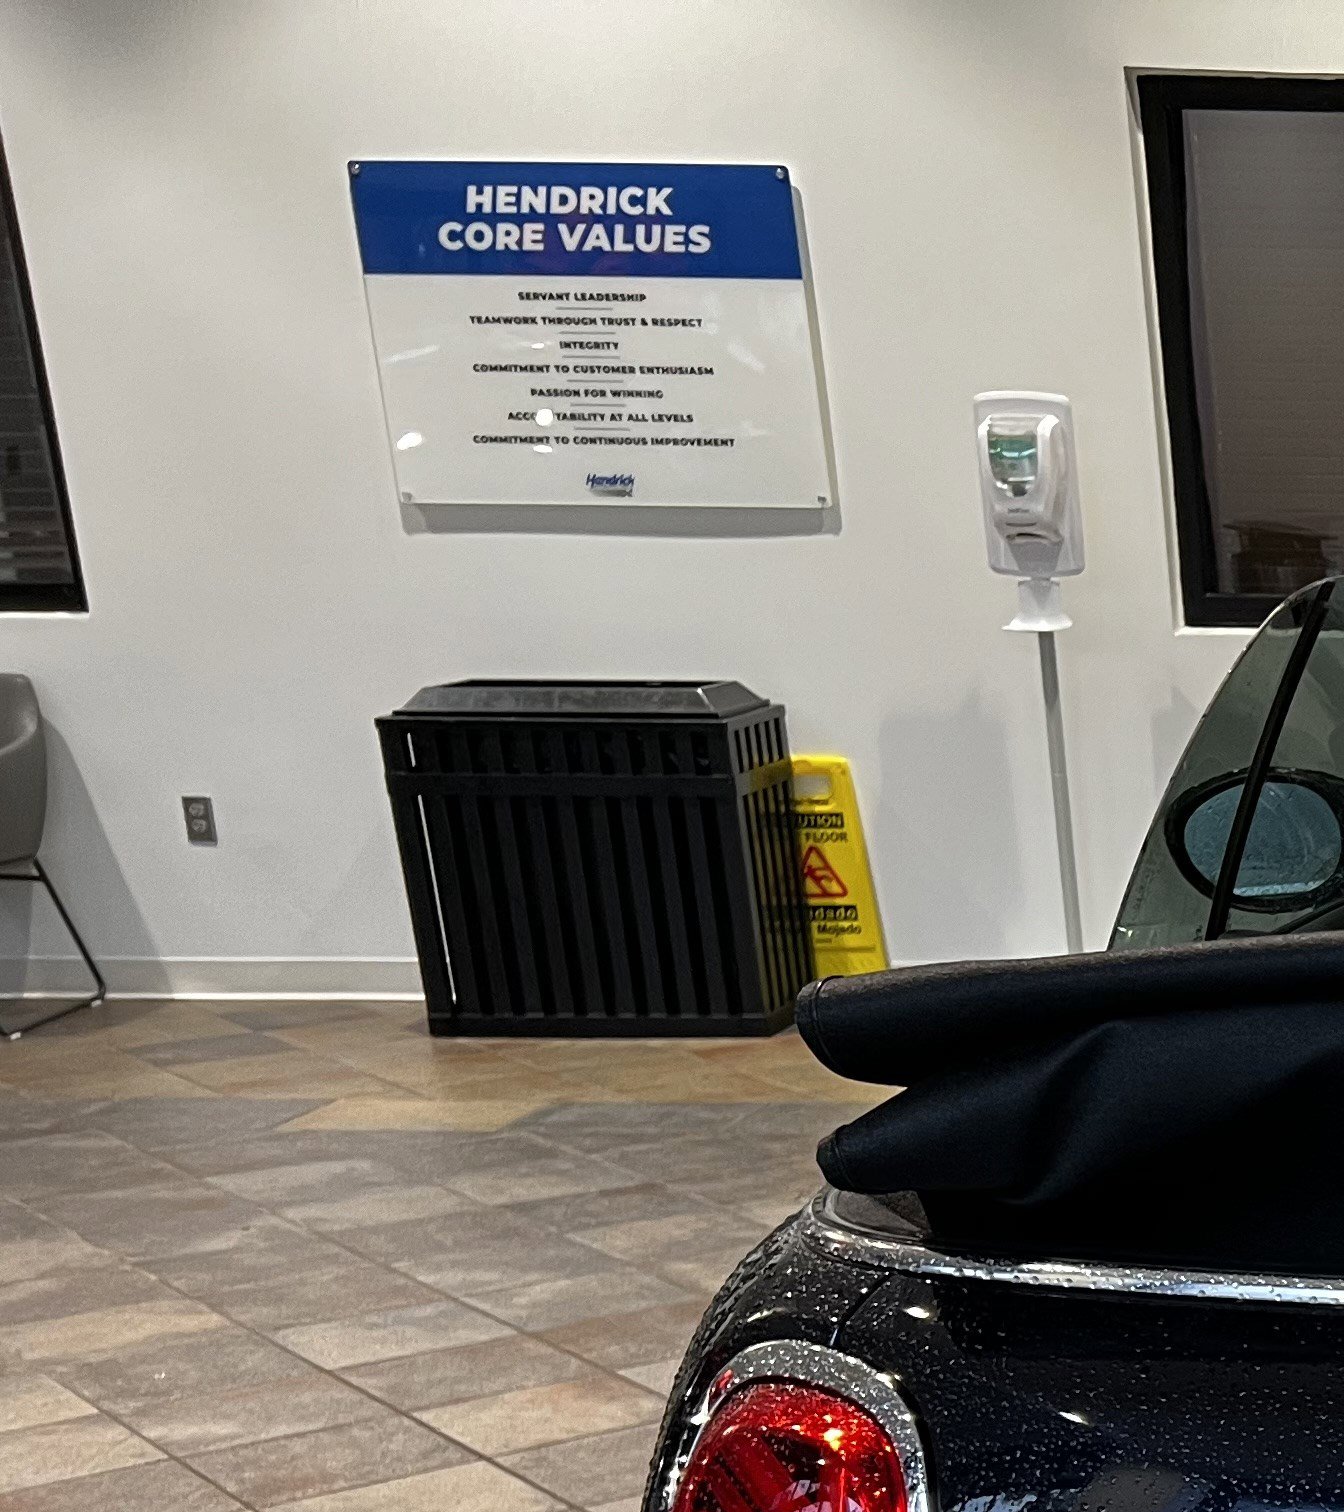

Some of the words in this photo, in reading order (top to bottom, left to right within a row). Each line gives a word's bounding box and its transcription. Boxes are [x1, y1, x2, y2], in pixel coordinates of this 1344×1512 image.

[466, 184, 674, 216] HENDRICK
[437, 221, 546, 252] CORE
[557, 223, 712, 254] VALUES
[517, 291, 571, 301] SERVANT
[574, 292, 647, 303] LEADERSHIP
[469, 315, 538, 326] TEAMWORK
[541, 316, 598, 326] THROUGH
[600, 317, 637, 327] TRUST
[640, 317, 649, 327] &
[651, 317, 703, 328] RESPECT
[559, 340, 619, 351] INTEGRITY
[472, 363, 551, 374] COMMITMENT
[553, 364, 570, 374] TO
[573, 365, 637, 375] CUSTOMER
[639, 366, 715, 376] ENTHUSIASM
[530, 387, 581, 398] PASSION
[584, 388, 607, 398] FOR
[609, 389, 664, 400] WINNING
[507, 411, 606, 422] ACCOTABILITY
[609, 412, 624, 422] AT
[627, 413, 649, 423] ALL
[651, 413, 694, 423] LEVELS
[472, 434, 551, 445] COMMITMENT
[553, 435, 570, 445] TO
[573, 436, 648, 446] CONTINUOUS
[651, 438, 735, 448] IMPROVEMENT
[805, 831, 849, 843] FLOOR
